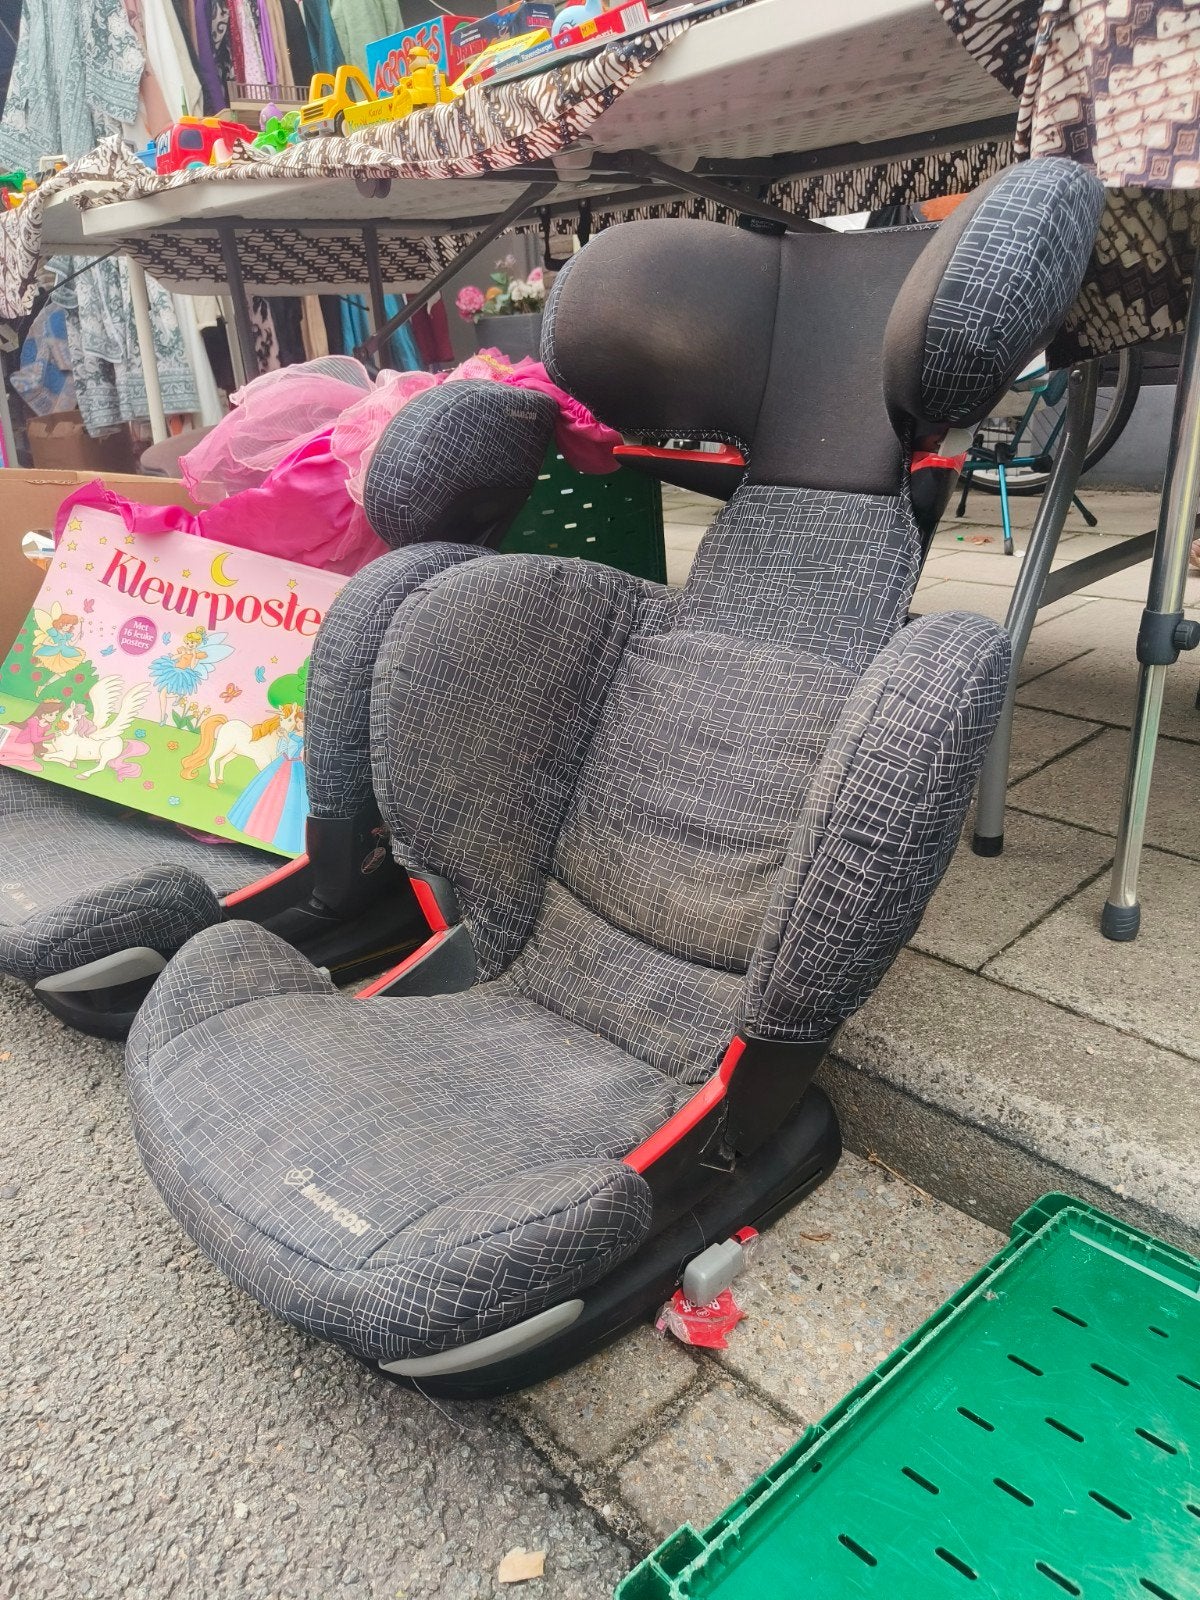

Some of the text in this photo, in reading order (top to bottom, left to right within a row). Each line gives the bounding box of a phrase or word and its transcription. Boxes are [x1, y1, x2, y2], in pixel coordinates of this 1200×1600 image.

[97, 548, 326, 637] Kleurposte
[133, 620, 149, 631] Met
[123, 628, 133, 637] 16
[120, 637, 150, 649] posters
